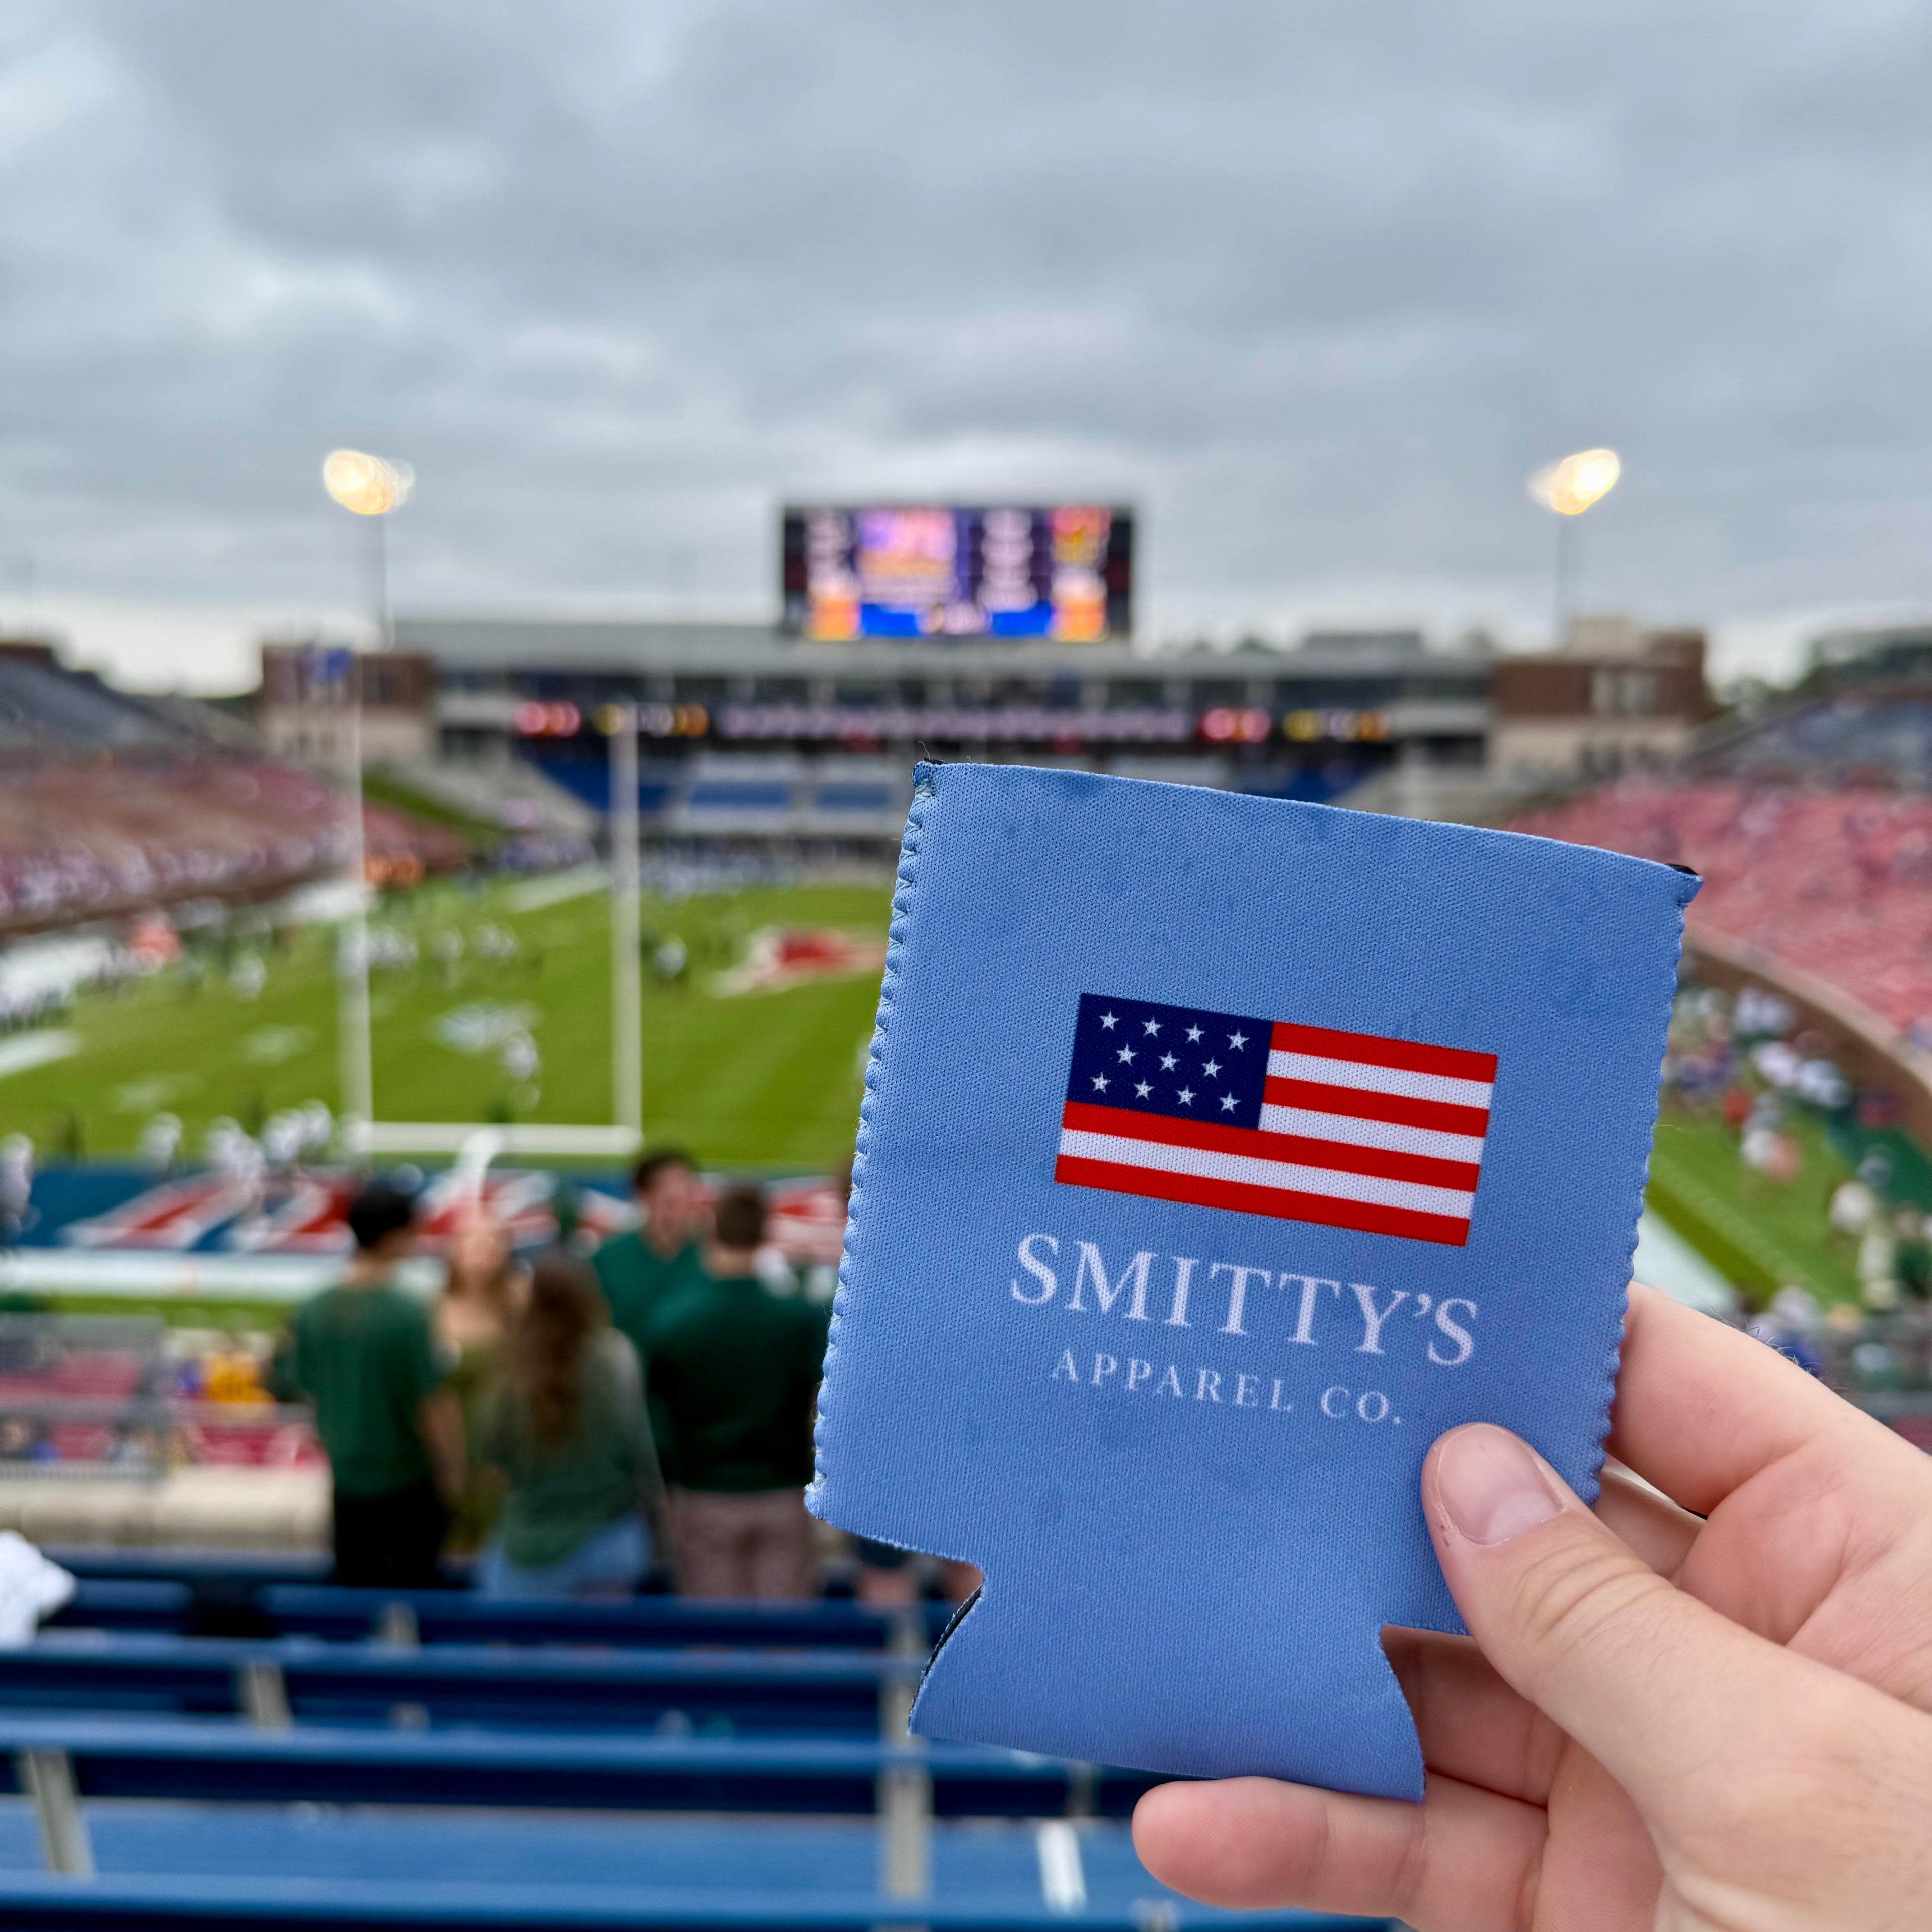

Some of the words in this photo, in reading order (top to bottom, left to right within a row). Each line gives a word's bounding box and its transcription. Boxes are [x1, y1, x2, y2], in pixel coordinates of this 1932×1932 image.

[1011, 1232, 1477, 1366] SMITTY'S
[1051, 1347, 1293, 1410] APPAREL
[1320, 1386, 1401, 1425] CO.
